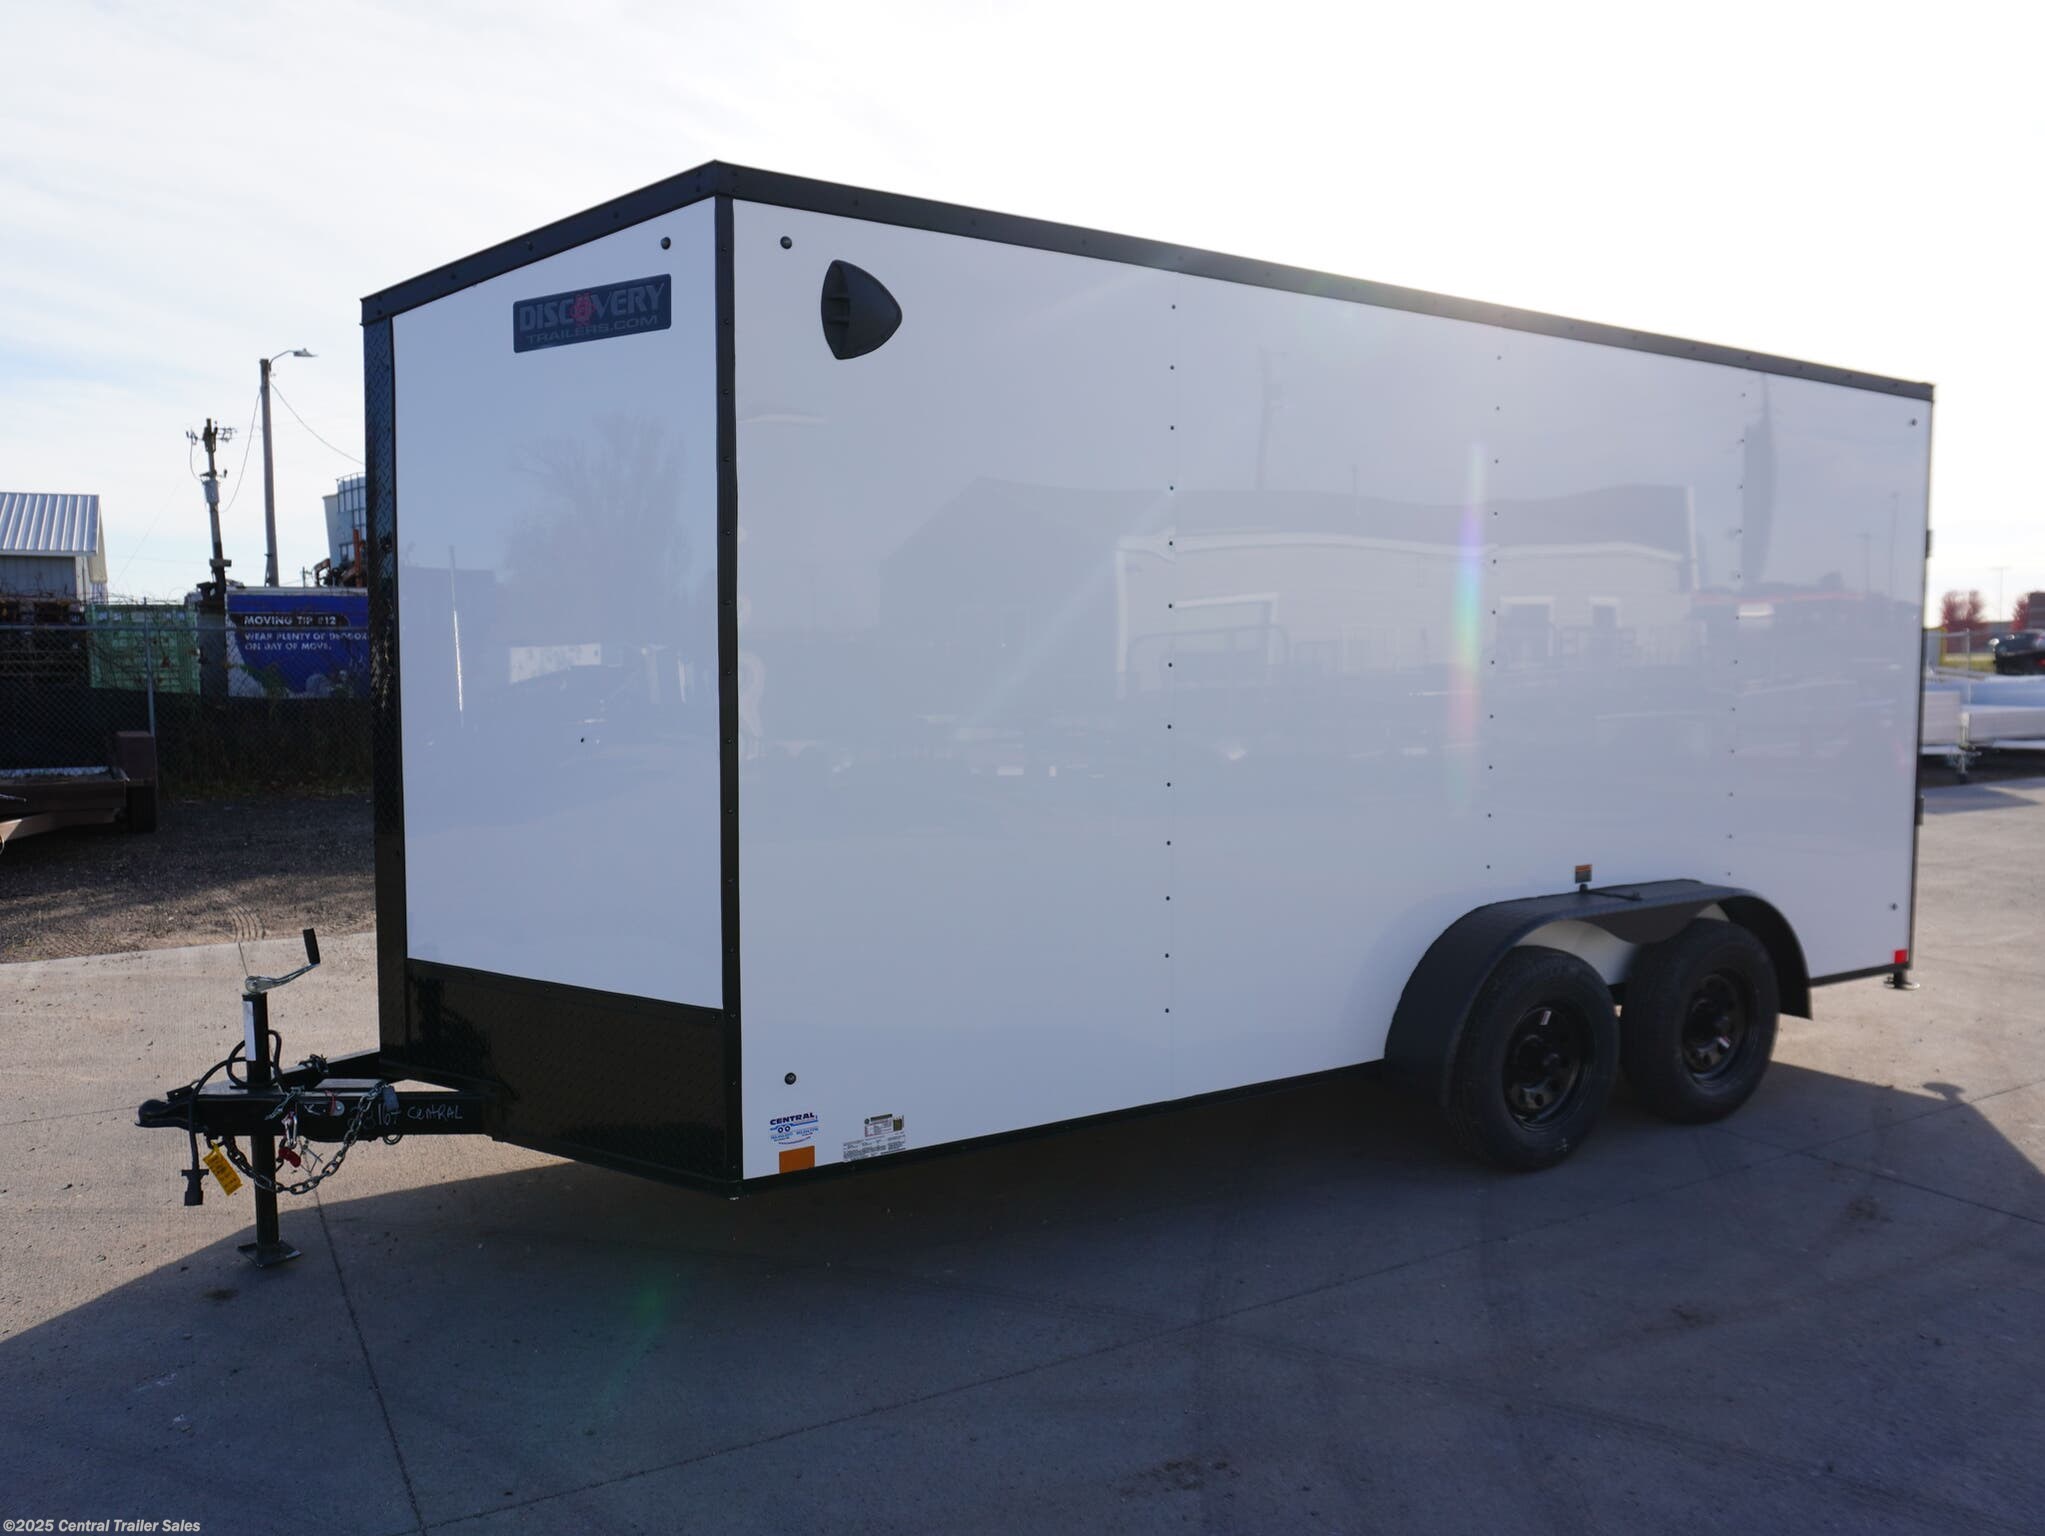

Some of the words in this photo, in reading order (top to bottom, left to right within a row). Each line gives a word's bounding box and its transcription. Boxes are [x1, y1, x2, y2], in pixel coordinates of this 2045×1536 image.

[519, 282, 665, 332] DISCOVERY
[527, 315, 658, 345] TRAILERS.COM
[244, 615, 293, 625] MOVING
[297, 615, 313, 625] TIP
[244, 632, 273, 641] WEAR
[277, 632, 311, 641] PLENTY
[312, 632, 326, 641] OF
[245, 642, 261, 651] ON
[285, 642, 298, 651] OF
[769, 1112, 815, 1126] CENTRAL
